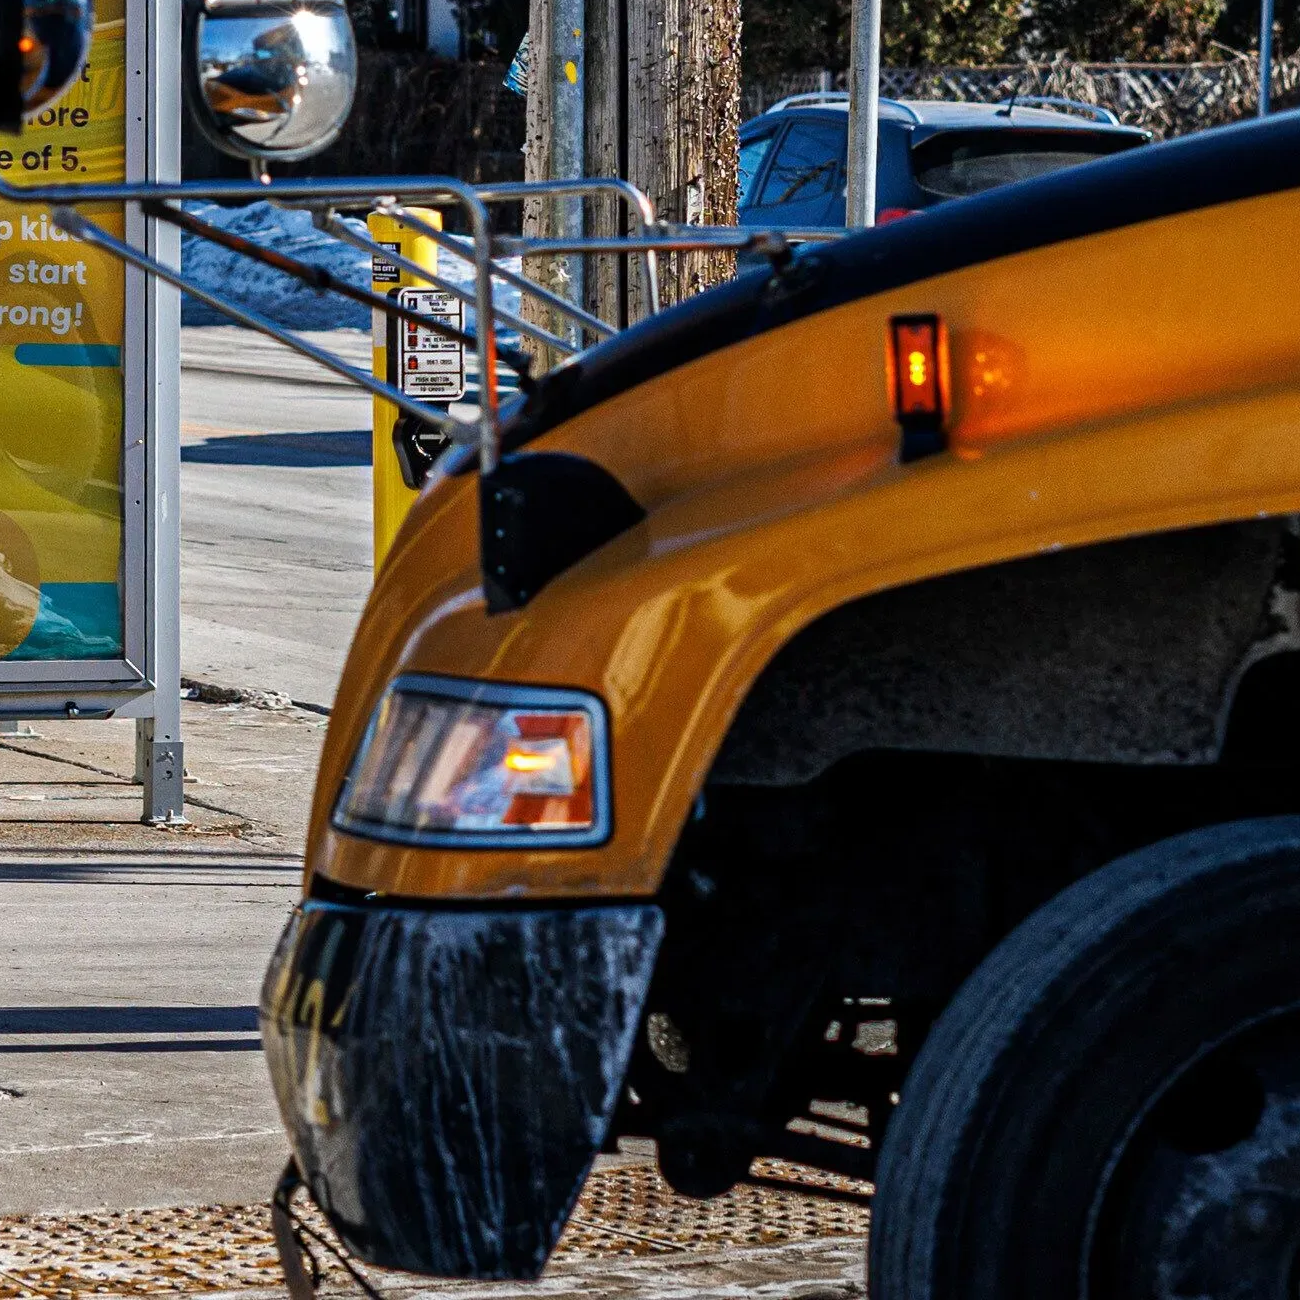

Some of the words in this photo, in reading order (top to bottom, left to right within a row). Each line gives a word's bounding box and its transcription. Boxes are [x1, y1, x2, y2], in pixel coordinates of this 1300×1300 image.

[21, 144, 52, 171] of
[60, 146, 88, 173] 5.
[9, 259, 87, 285] start
